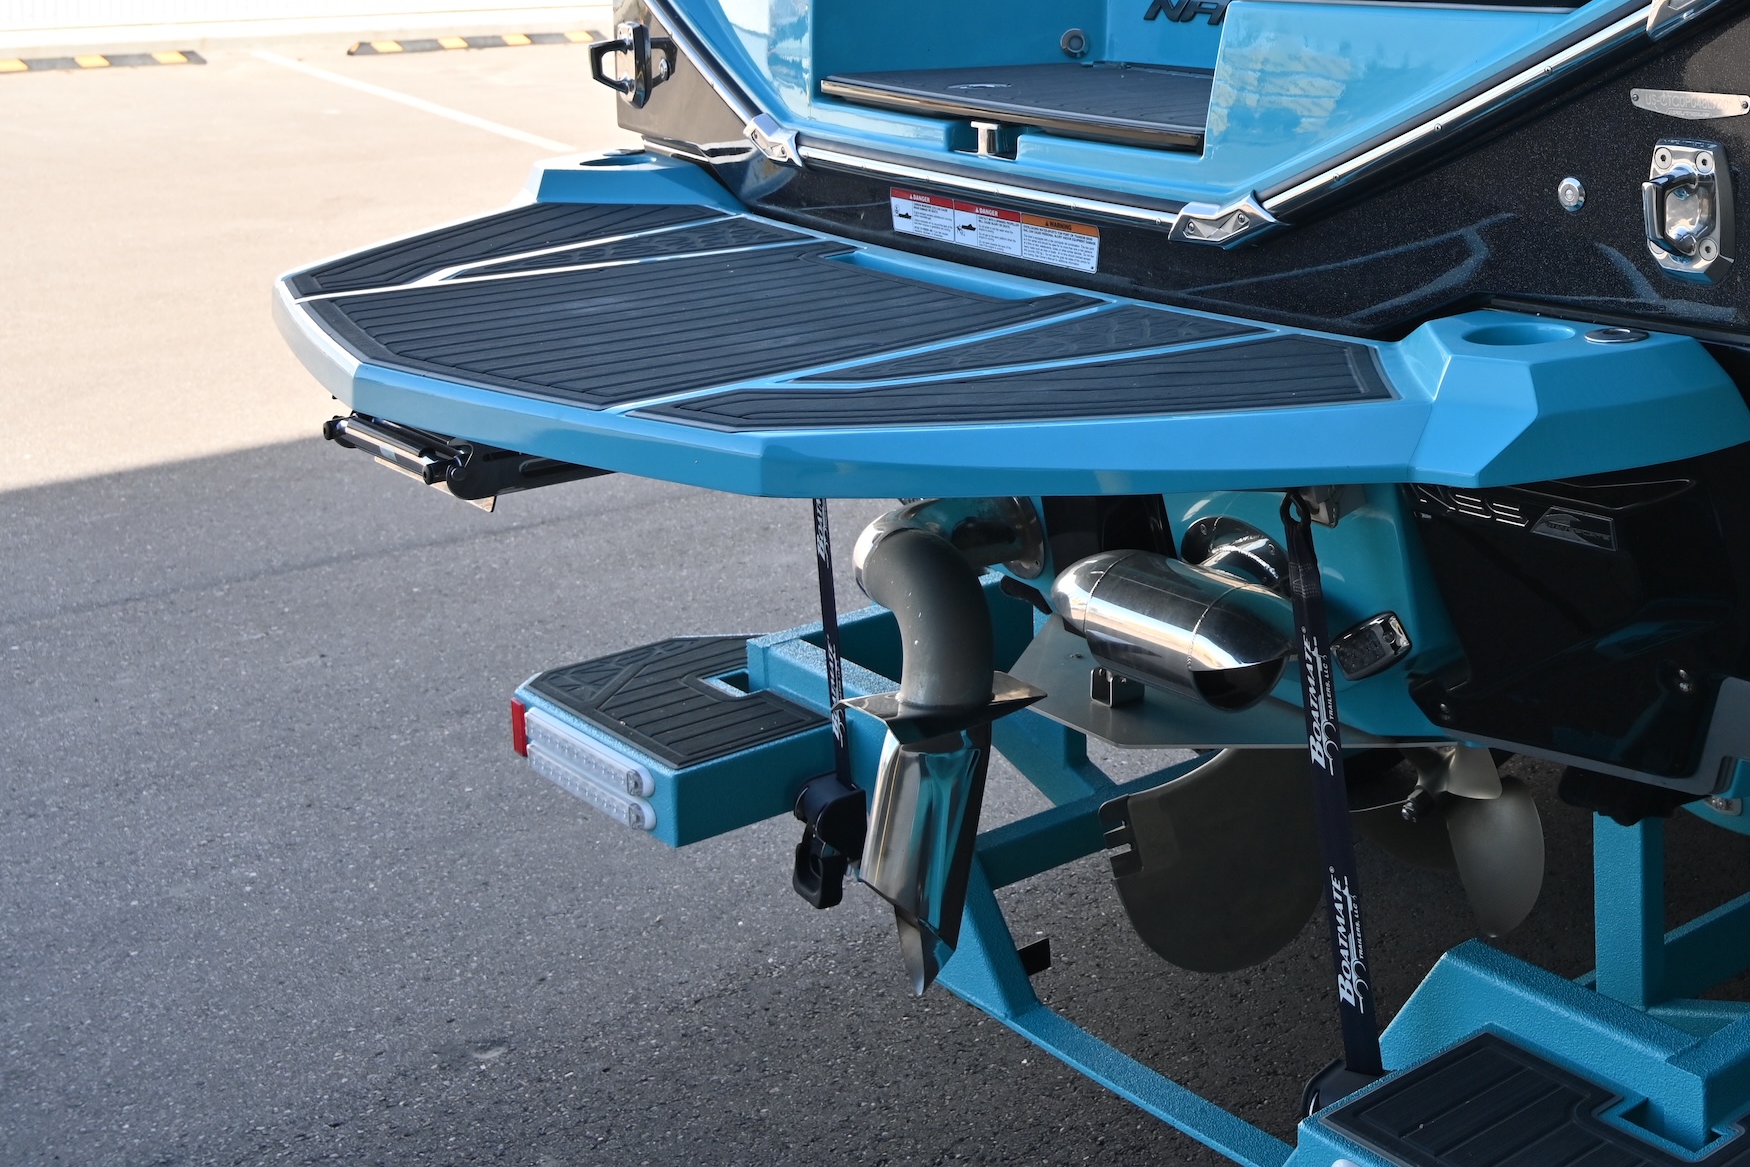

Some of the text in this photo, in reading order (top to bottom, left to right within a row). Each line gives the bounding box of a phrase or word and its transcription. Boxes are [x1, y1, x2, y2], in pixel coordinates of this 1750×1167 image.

[912, 194, 930, 203] DANGER
[979, 208, 998, 217] DANGER
[1049, 221, 1072, 230] WARNING
